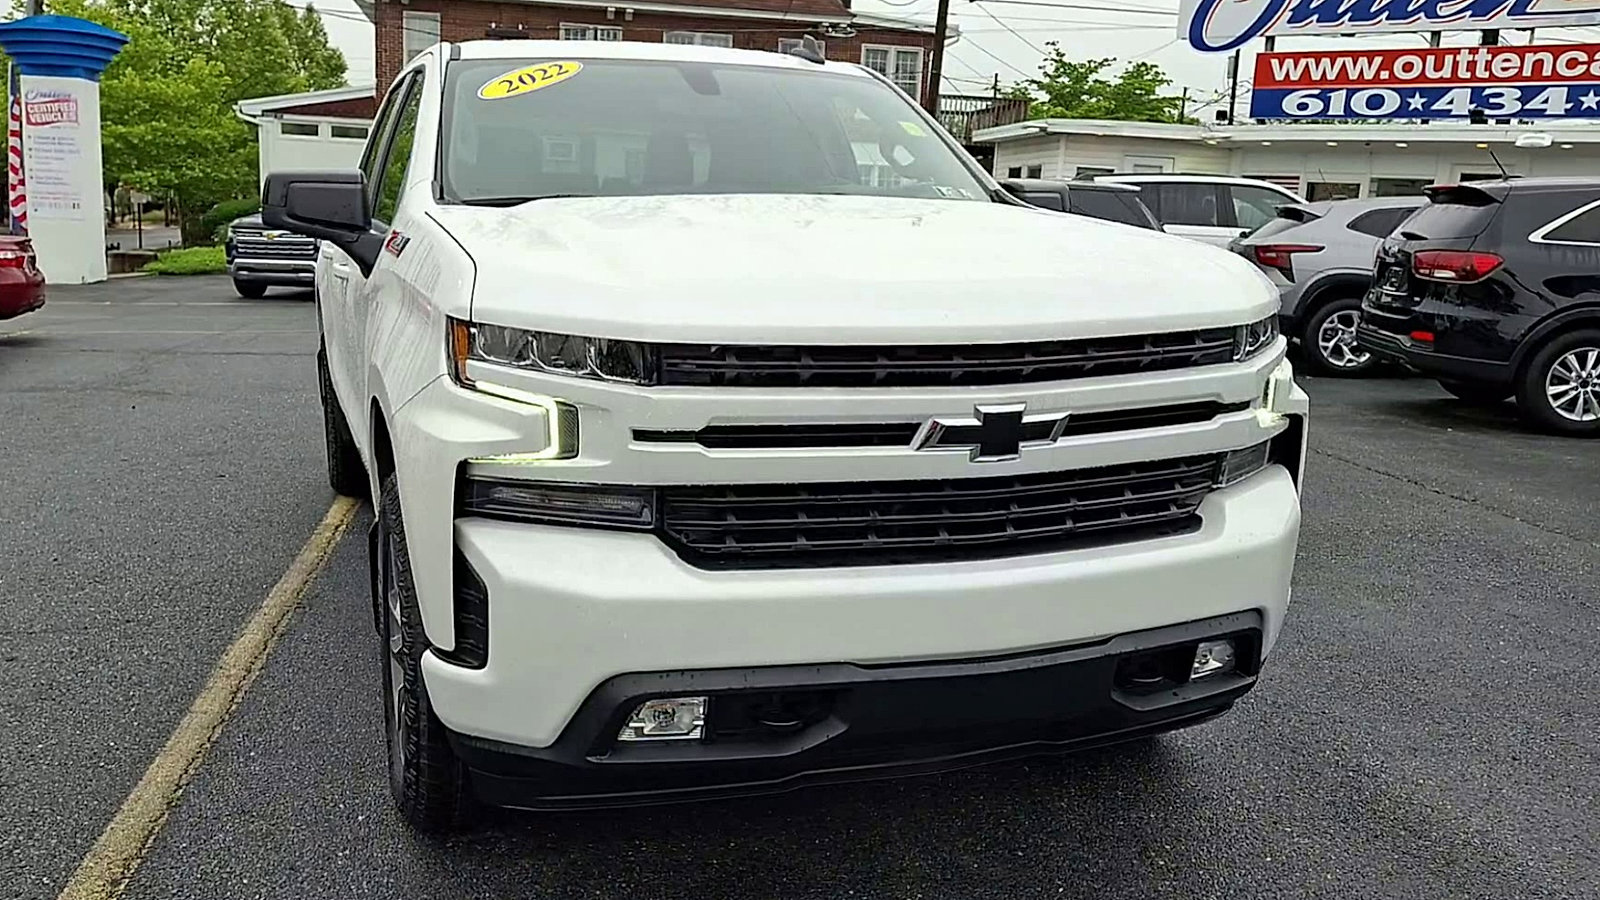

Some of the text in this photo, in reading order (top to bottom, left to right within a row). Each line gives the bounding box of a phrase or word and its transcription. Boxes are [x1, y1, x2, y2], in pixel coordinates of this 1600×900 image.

[498, 64, 569, 93] 2022
[27, 102, 76, 114] CERTIFIED
[1282, 87, 1574, 116] 610 434
[28, 112, 77, 123] VEHICLES
